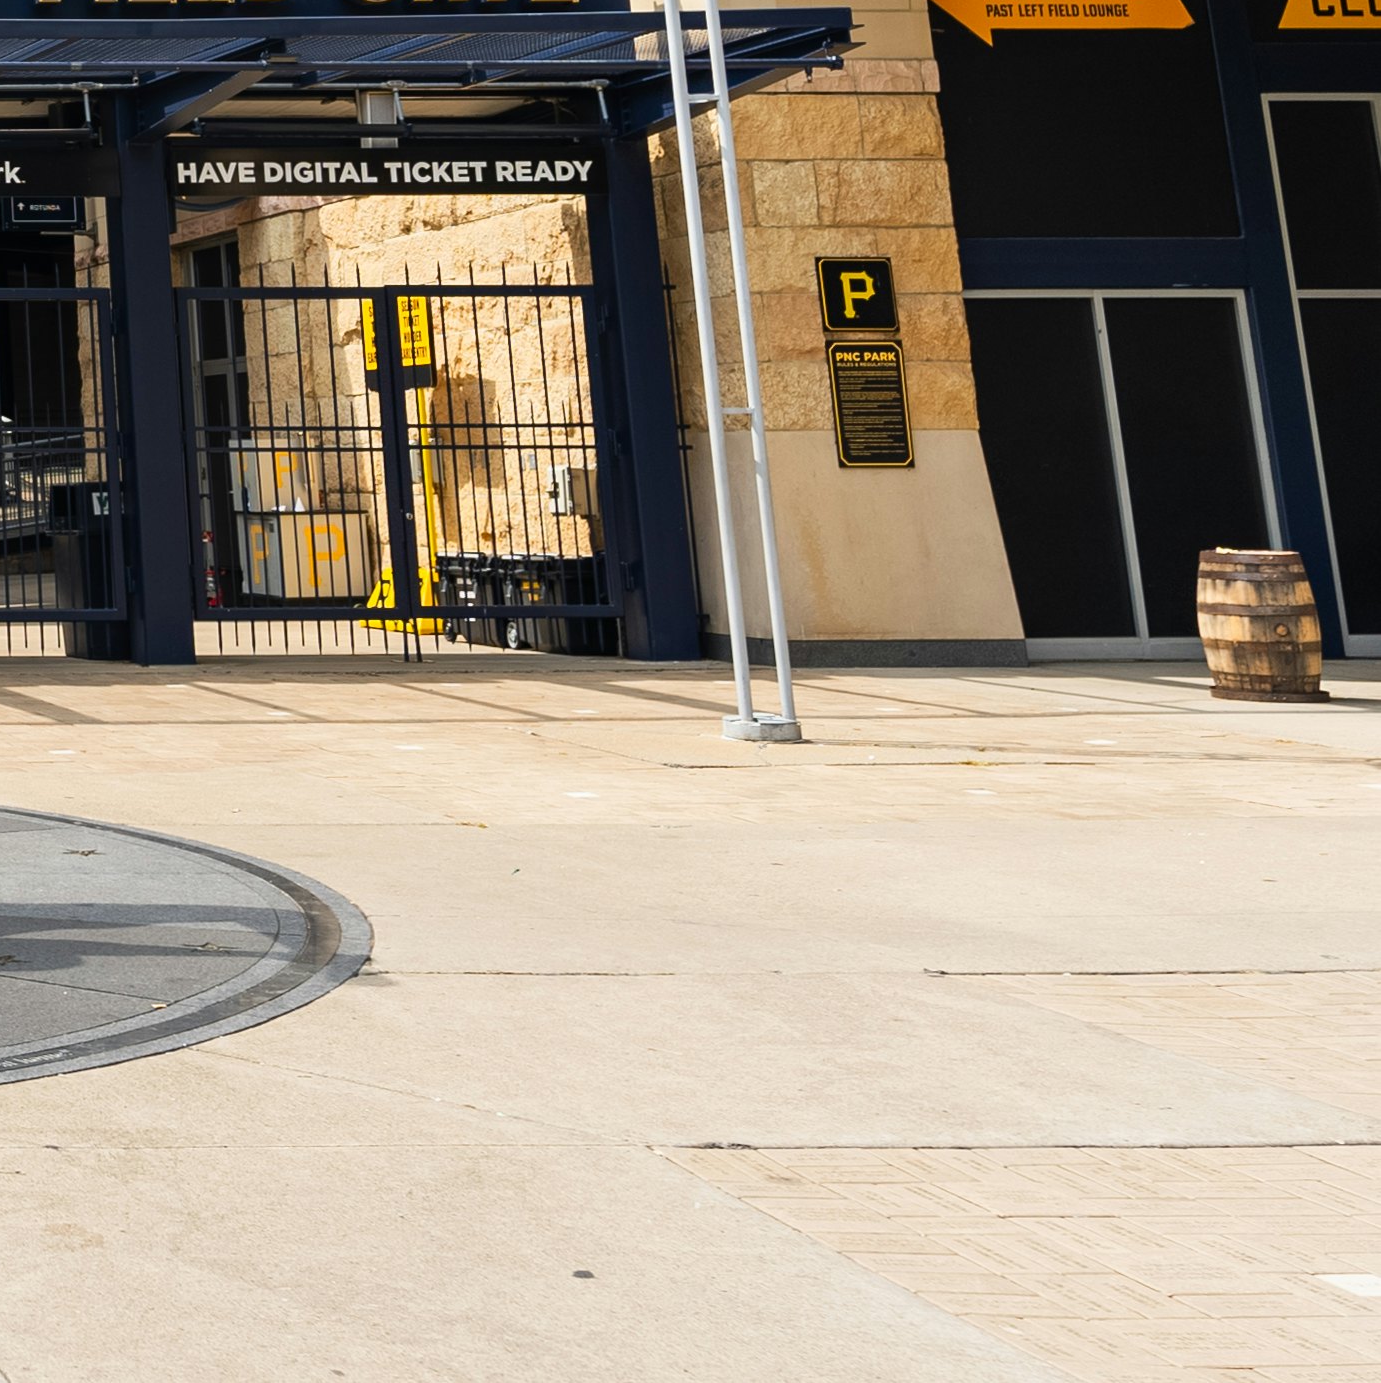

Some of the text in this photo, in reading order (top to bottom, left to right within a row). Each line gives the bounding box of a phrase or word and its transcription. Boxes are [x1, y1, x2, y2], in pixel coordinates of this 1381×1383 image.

[985, 3, 1130, 18] PAST LEFT FIELD LOUNGE
[176, 160, 593, 184] HAVE DIGITAL TICKET READY
[840, 270, 876, 319] P
[835, 351, 897, 362] PNC PARK
